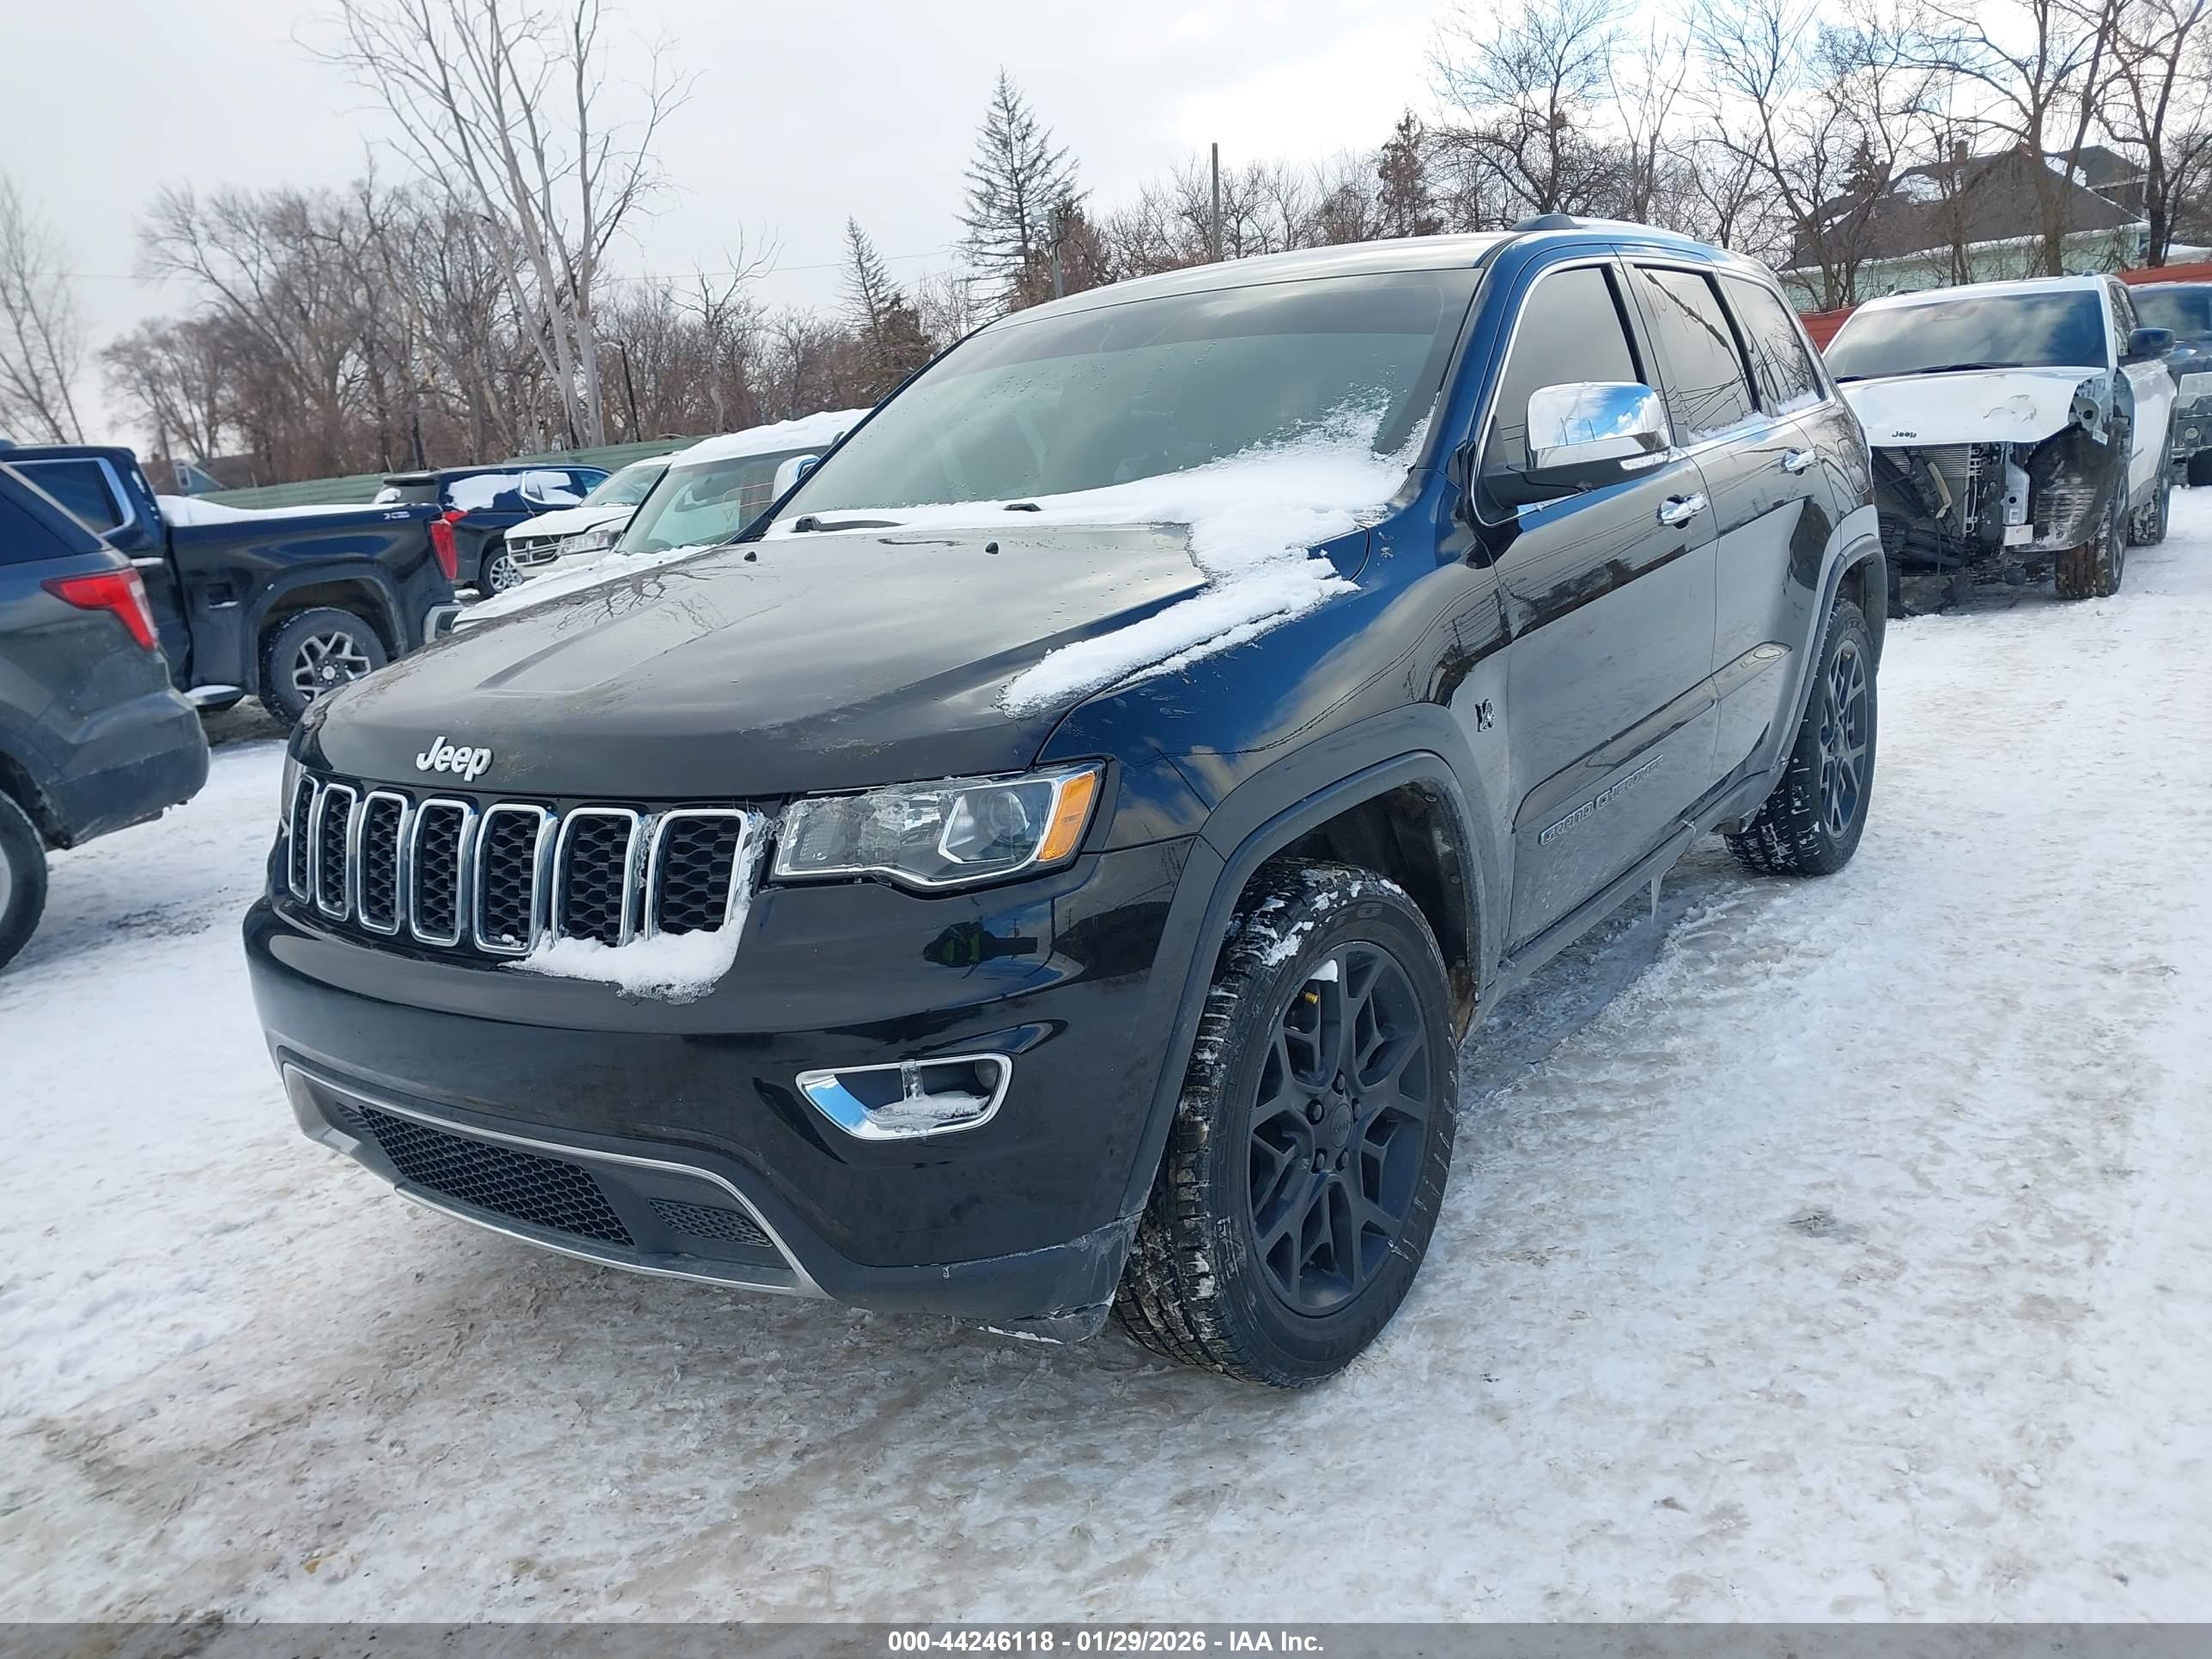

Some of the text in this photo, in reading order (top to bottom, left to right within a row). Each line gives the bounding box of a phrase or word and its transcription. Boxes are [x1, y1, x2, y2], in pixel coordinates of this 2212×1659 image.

[416, 736, 493, 782] Jeep
[1540, 754, 1663, 845] GRAND CHEROKEE
